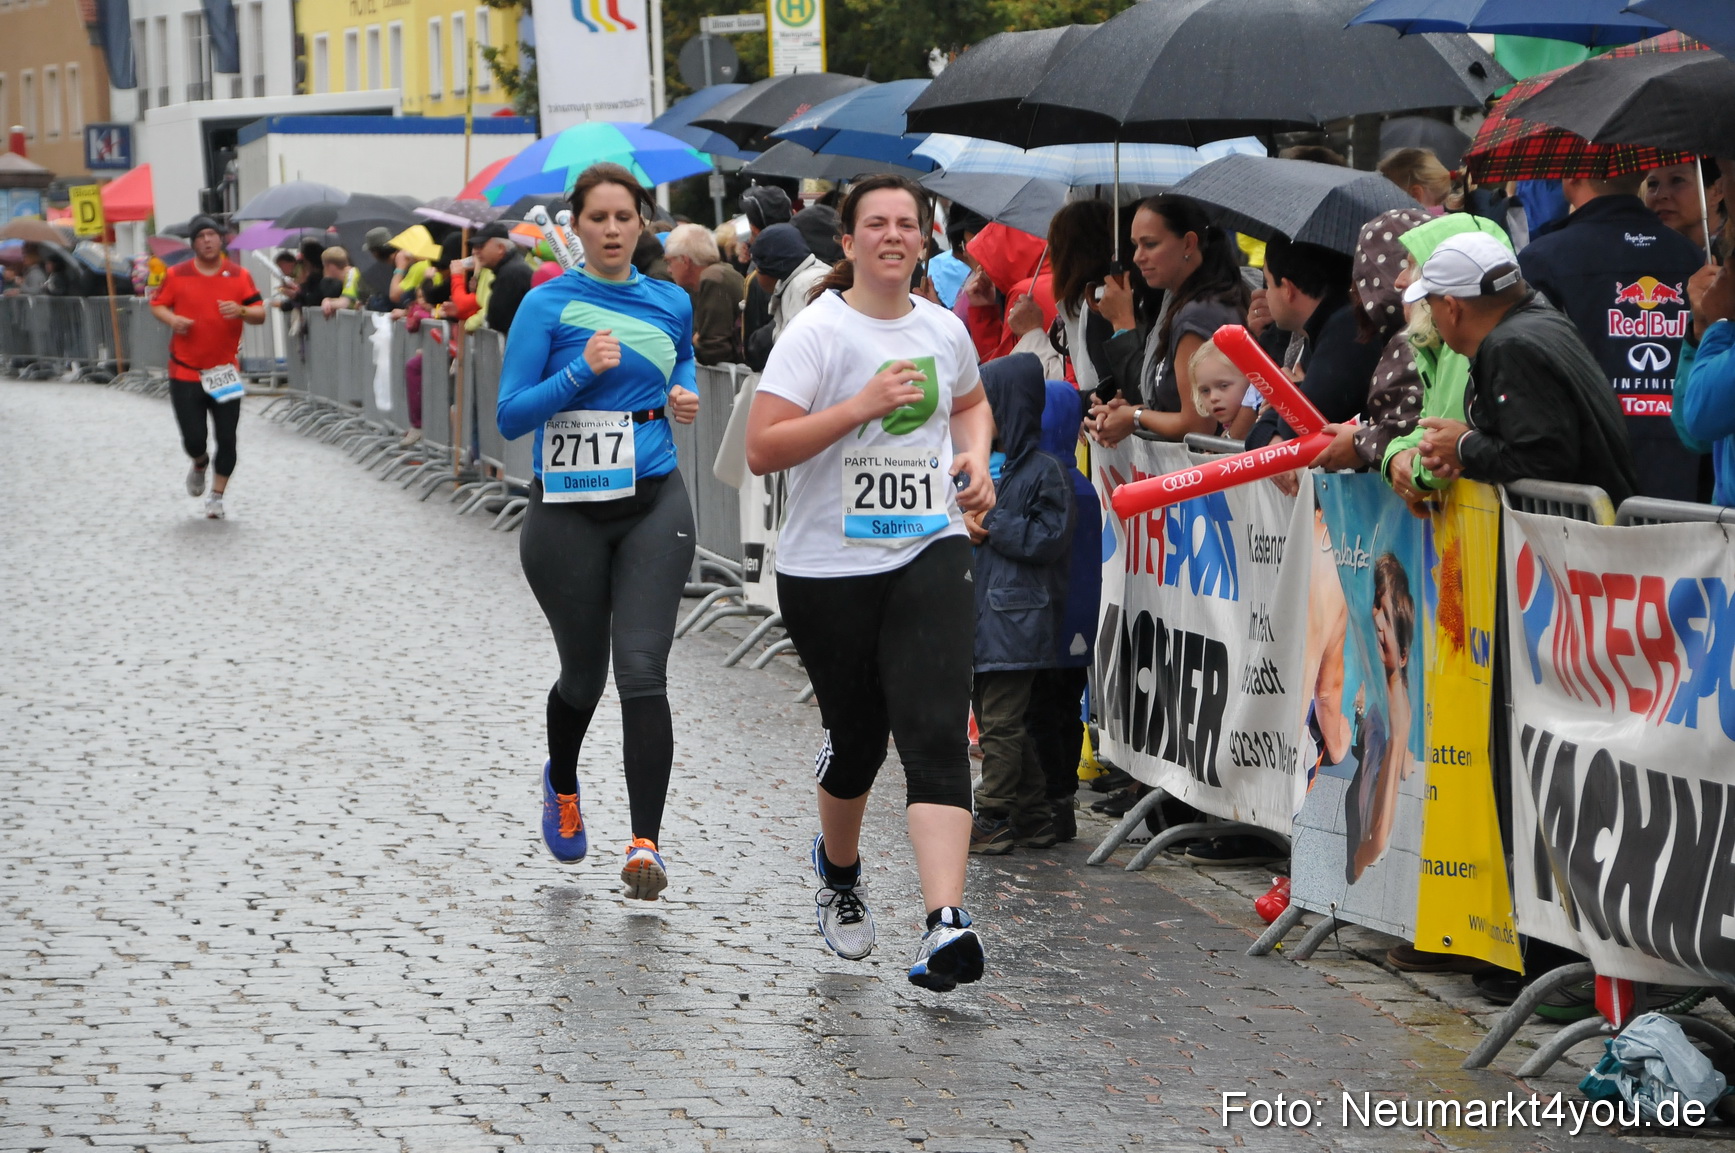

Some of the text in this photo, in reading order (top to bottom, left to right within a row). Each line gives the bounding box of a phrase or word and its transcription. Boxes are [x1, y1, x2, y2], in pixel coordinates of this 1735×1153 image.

[551, 432, 623, 466] 2717
[844, 457, 927, 468] PARTL Neumarkt
[1218, 442, 1301, 477] Audi BKK
[564, 475, 610, 489] Daniela
[854, 472, 932, 510] 2051
[871, 520, 925, 535] Sabrina
[1230, 730, 1276, 770] 92318
